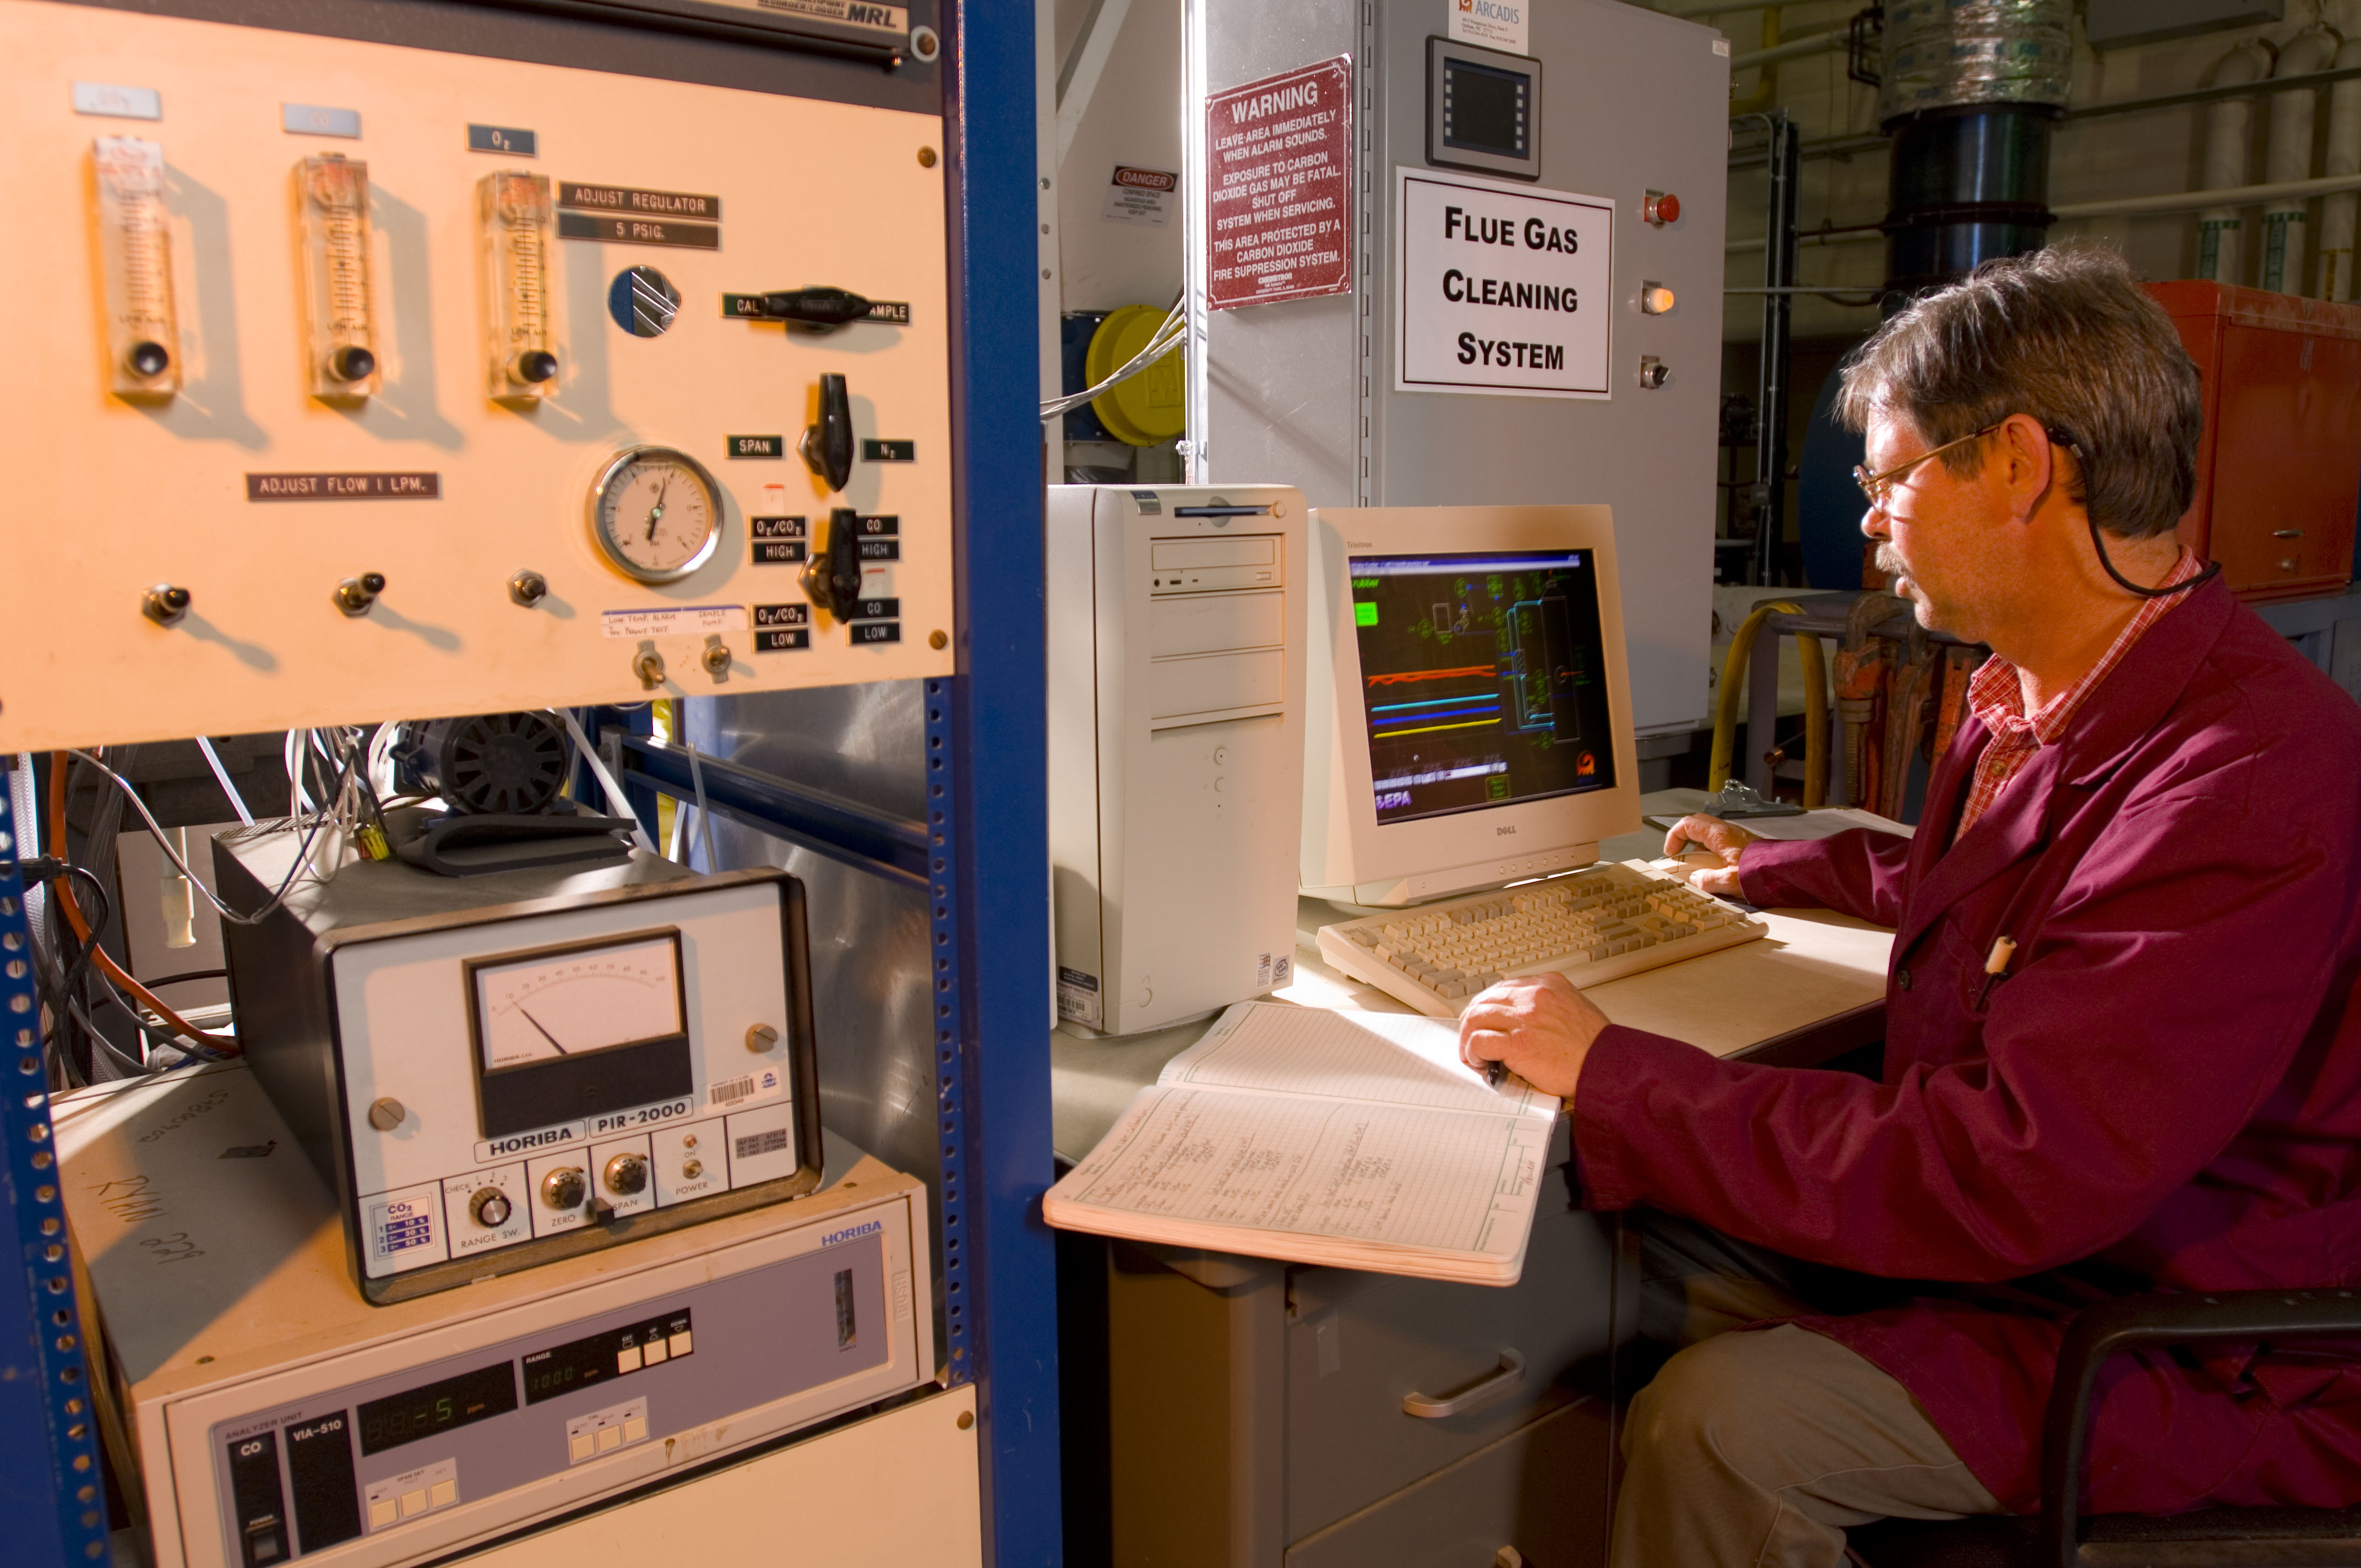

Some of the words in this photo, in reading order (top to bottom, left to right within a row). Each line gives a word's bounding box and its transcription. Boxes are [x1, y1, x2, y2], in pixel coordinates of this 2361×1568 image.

[847, 3, 896, 28] MRL
[1476, 1, 1519, 24] ARCADIS
[1232, 81, 1318, 124] WARNING
[1216, 133, 1244, 151] LEAVE
[1246, 127, 1270, 143] AREA
[1272, 109, 1336, 136] IMMEDIATELY
[1223, 147, 1249, 163] WHEN
[1251, 138, 1283, 155] ALARM
[1285, 127, 1328, 149] SOUNDS.
[1223, 164, 1271, 186] EXPOSURE
[1272, 161, 1285, 174] TO
[1287, 151, 1328, 171] CARBON
[1122, 171, 1168, 187] DANGER
[1213, 185, 1247, 203] DIOXIDE
[1249, 181, 1267, 194] GAS
[1270, 175, 1291, 190] MAY
[1293, 171, 1305, 185] BE
[1308, 165, 1341, 182] FATAL.
[575, 188, 624, 207] ADJUST
[633, 193, 707, 214] REGULATOR
[1252, 193, 1276, 209] SHUT
[1278, 189, 1297, 203] OFF
[1217, 214, 1252, 231] SYSTEM
[1253, 208, 1281, 223] WHEN
[1282, 197, 1336, 218] SERVICING.
[616, 222, 624, 236] 5
[633, 223, 665, 239] PSIG.
[1214, 239, 1233, 253] THIS
[1235, 233, 1259, 249] AREA
[1261, 224, 1316, 243] PROTECTED
[1319, 220, 1332, 233] BY
[1334, 219, 1341, 231] A
[1445, 204, 1515, 247] FLUE
[1524, 217, 1579, 254] GAS
[1237, 246, 1275, 263] CARBON
[1276, 239, 1314, 256] DIOXIDE
[1214, 268, 1233, 281] FIRE
[1234, 257, 1298, 279] SUPPRESSION
[1299, 250, 1340, 268] SYSTEM.
[1442, 268, 1579, 313] CLEANING
[1457, 331, 1564, 371] SYSTEM
[739, 440, 770, 454] SPAN
[259, 477, 317, 494] ADJUST
[327, 476, 368, 493] FLOW
[390, 476, 427, 492] LPM.
[866, 519, 882, 533] CO
[766, 545, 795, 559] HIGH
[862, 543, 889, 556] HIGH
[867, 602, 881, 614] CO
[771, 633, 796, 647] LOW
[864, 626, 888, 640] LOW
[1497, 826, 1516, 836] DELL
[597, 1102, 686, 1133] PIR-2000
[489, 1127, 573, 1157] HORIBA
[684, 1150, 696, 1158] ON
[444, 1184, 471, 1194] CHECK
[675, 1181, 709, 1196] POWER
[612, 1198, 638, 1212] SPAN
[390, 1211, 414, 1221] RANGE
[551, 1215, 576, 1228] ZERO
[379, 1235, 385, 1244] 2
[460, 1233, 497, 1249] RANGE
[502, 1228, 520, 1239] SW.
[821, 1221, 882, 1247] HORIBA
[670, 1319, 687, 1327] DOWN
[526, 1351, 551, 1364] RANGE
[467, 1403, 485, 1414] ppm
[225, 1419, 279, 1440] ANALYZER
[280, 1411, 303, 1424] UNIT
[293, 1419, 342, 1441] VIA-510
[241, 1441, 262, 1457] CO
